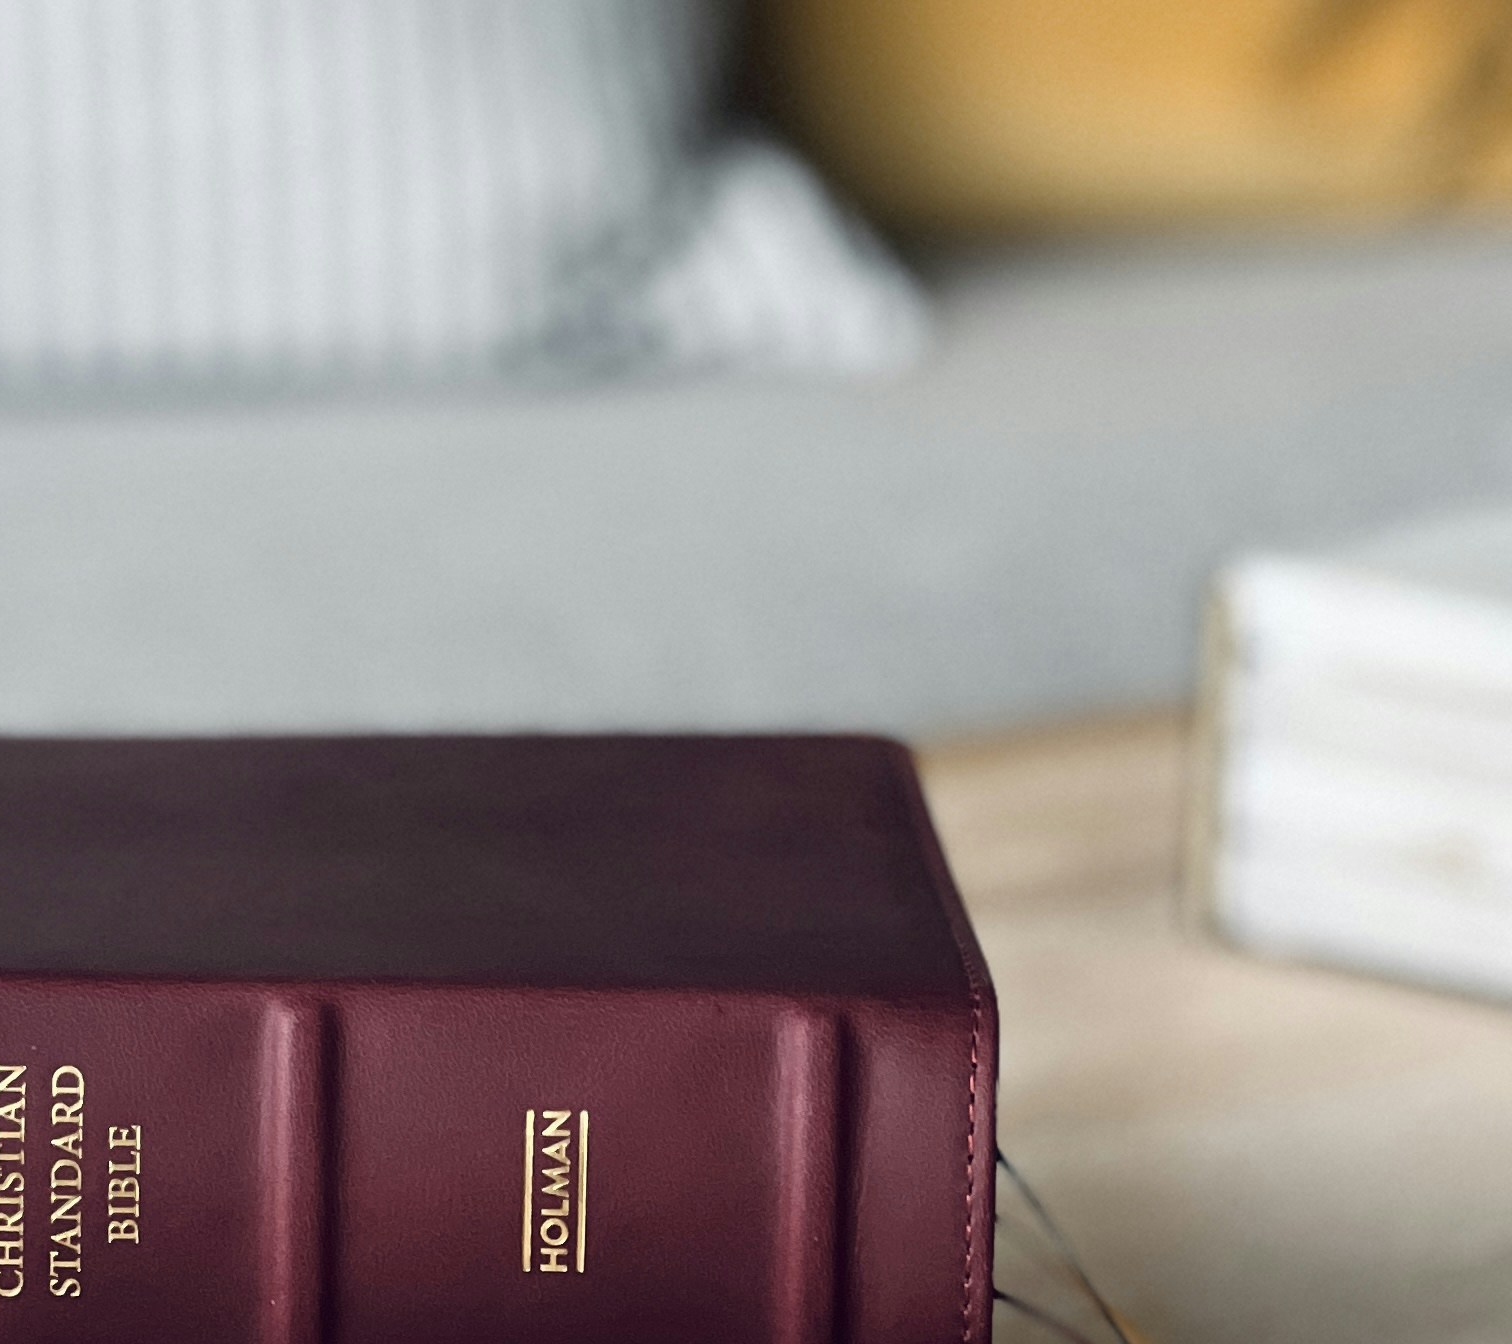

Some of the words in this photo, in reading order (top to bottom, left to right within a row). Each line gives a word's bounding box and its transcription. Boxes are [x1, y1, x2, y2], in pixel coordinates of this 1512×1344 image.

[50, 1066, 84, 1296] STANDARD
[108, 1125, 141, 1244] BIBLE
[540, 1110, 571, 1272] HOLMAN
